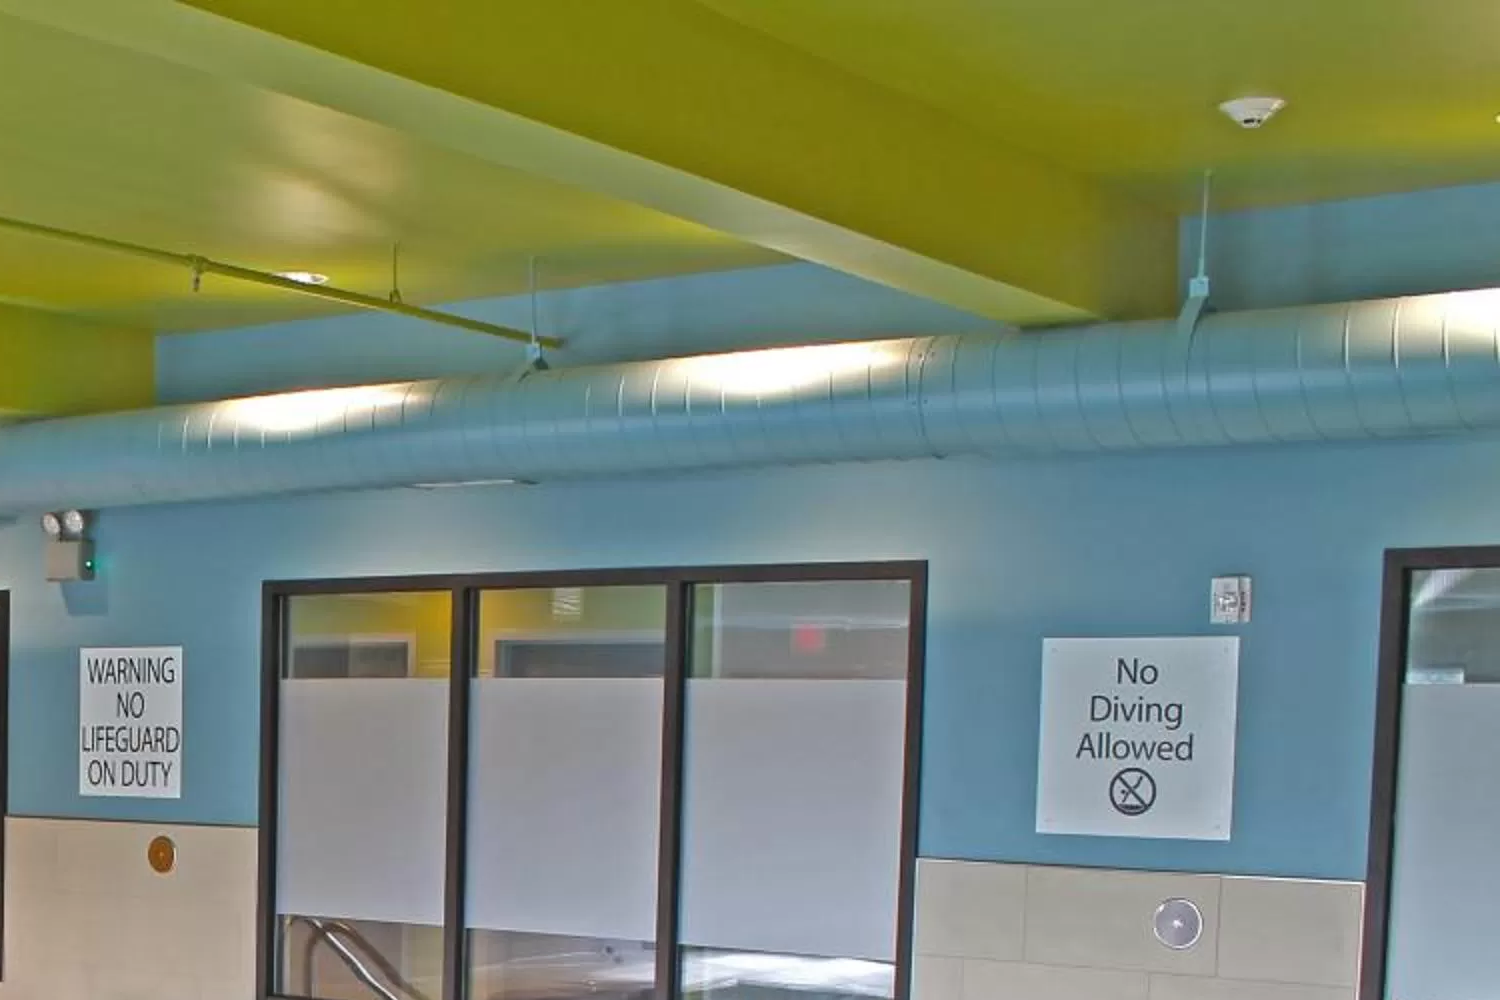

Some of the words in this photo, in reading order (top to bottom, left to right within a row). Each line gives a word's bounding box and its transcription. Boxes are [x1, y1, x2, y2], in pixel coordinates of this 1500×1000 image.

[87, 657, 175, 684] WARNING
[1116, 657, 1159, 685] No
[116, 691, 145, 718] NO
[1090, 695, 1183, 731] Diving
[82, 726, 180, 753] LIFEGUARD
[1076, 732, 1194, 761] Allowed
[88, 759, 115, 787] ON
[121, 760, 172, 787] DUTY
